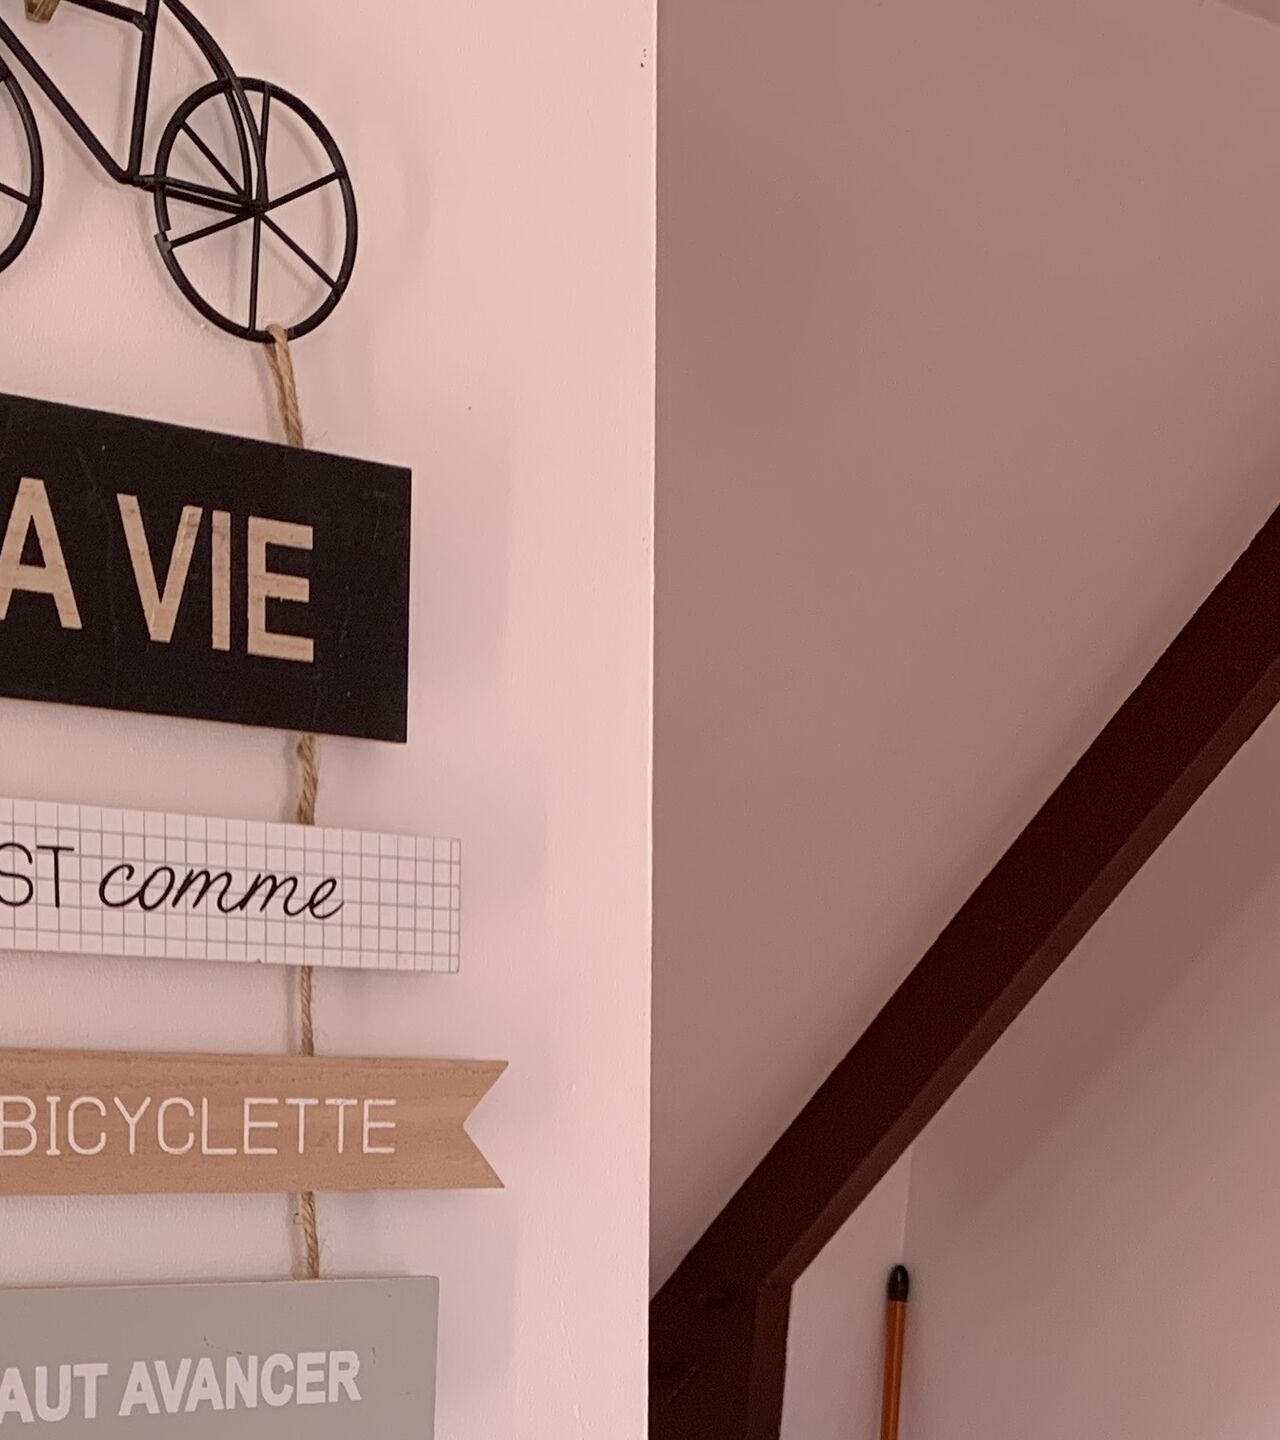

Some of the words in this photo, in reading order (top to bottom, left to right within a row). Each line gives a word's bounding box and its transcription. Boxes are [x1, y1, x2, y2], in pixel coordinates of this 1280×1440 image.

[116, 493, 315, 663] VIE
[97, 862, 345, 921] comme
[119, 1349, 363, 1417] AVANCER
